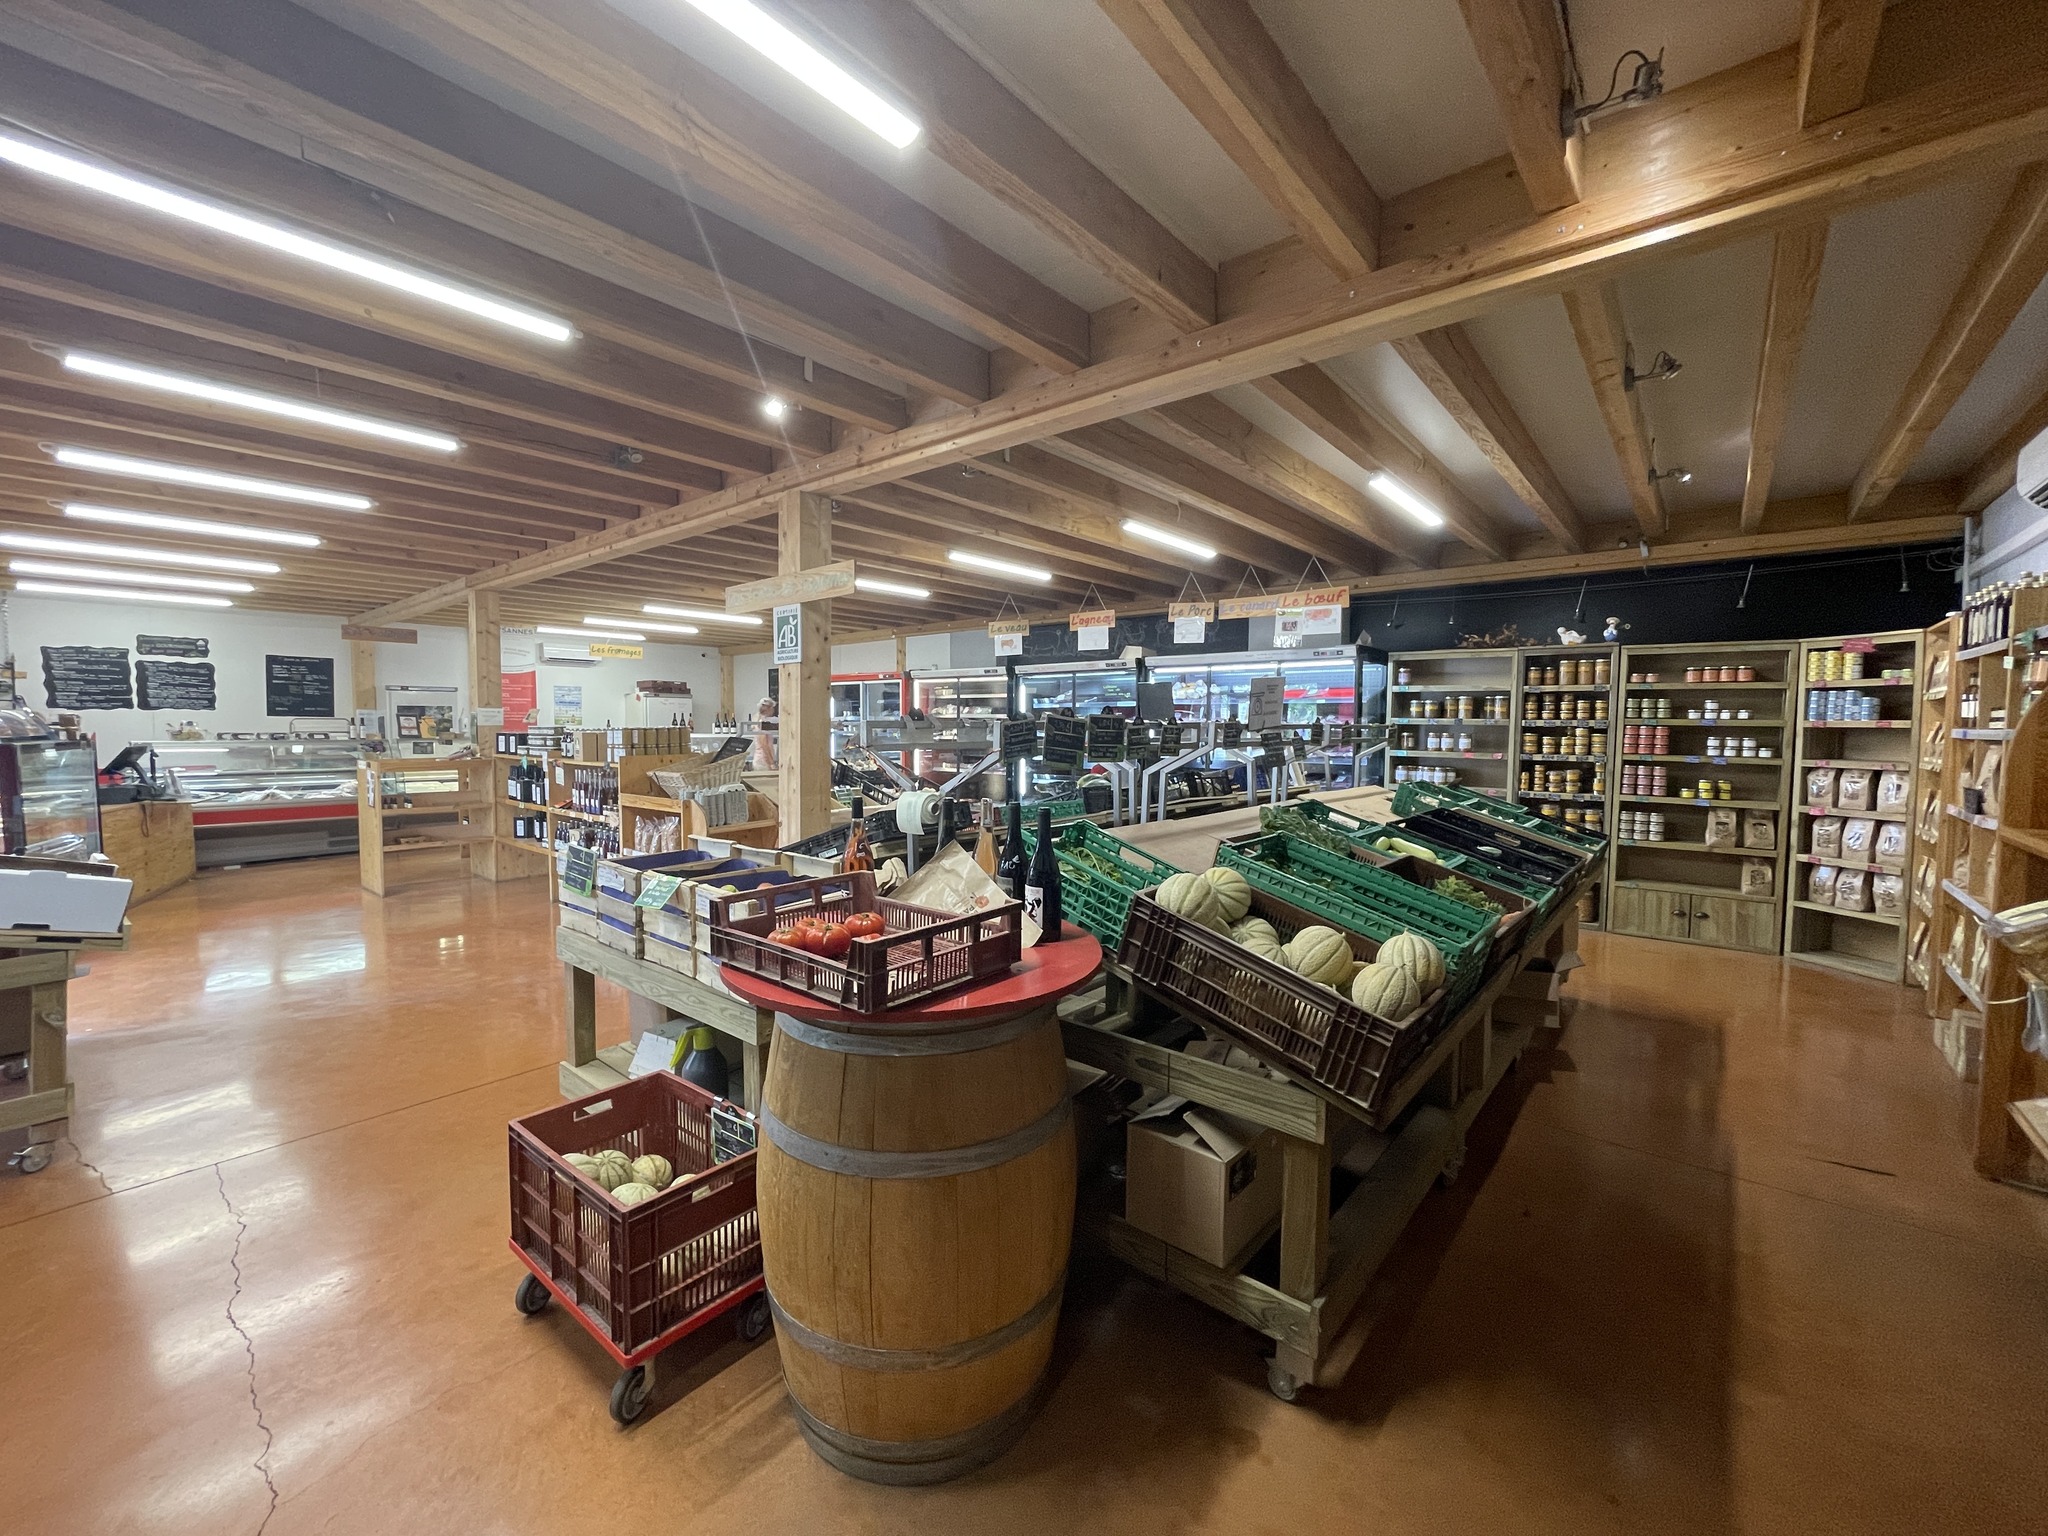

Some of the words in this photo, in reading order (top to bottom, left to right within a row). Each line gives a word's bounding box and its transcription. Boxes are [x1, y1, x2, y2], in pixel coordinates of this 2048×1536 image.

[1282, 596, 1300, 607] Le
[1304, 589, 1347, 606] bœuf
[1170, 606, 1184, 616] Le
[1187, 604, 1212, 616] Porc
[1220, 603, 1236, 614] Le
[1071, 615, 1114, 627] L'agneau
[990, 624, 1003, 633] Le
[1005, 624, 1027, 633] veau
[778, 624, 798, 648] AB
[591, 645, 606, 653] Les
[607, 646, 642, 657] fromages
